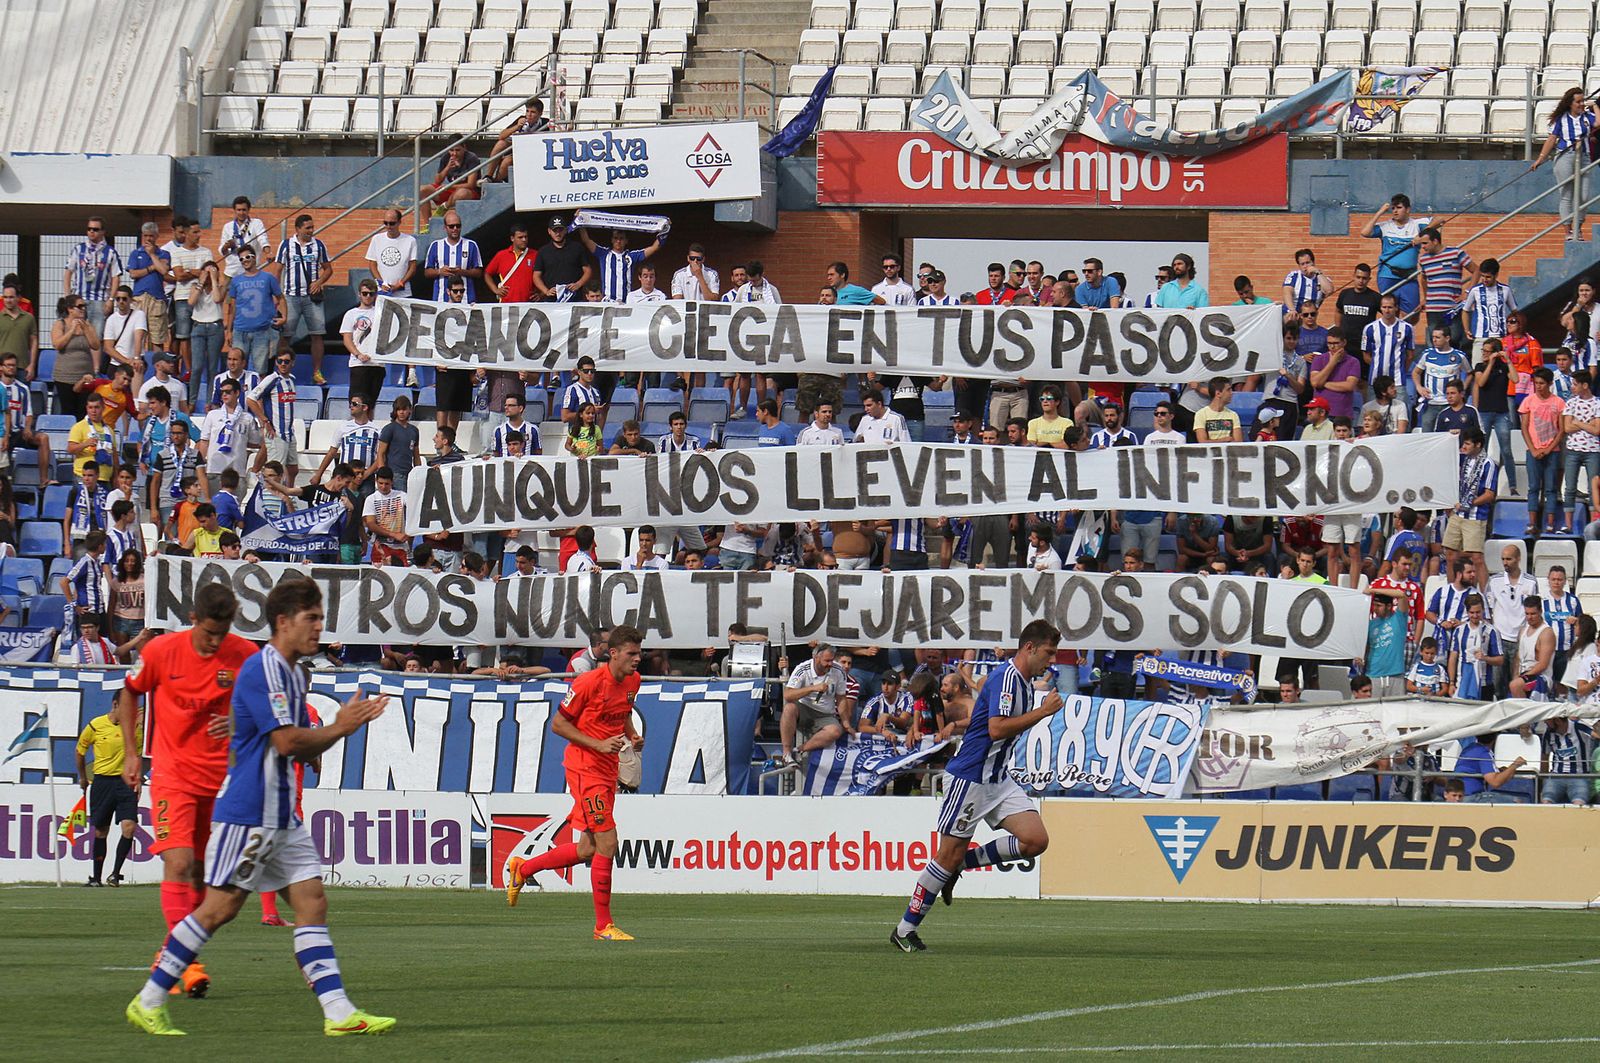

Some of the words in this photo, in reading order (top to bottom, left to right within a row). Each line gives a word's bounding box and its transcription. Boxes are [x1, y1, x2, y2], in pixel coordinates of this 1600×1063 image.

[699, 80, 751, 92] SECTO
[542, 131, 649, 170] Huelva
[685, 151, 732, 168] CEOSA
[569, 166, 599, 183] me
[606, 163, 649, 185] pone
[897, 138, 1171, 202] Cruzcampo
[540, 195, 548, 203] Y
[549, 194, 563, 203] EL
[566, 192, 604, 202] RECRE
[607, 187, 656, 200] TAMBIÉN
[241, 289, 263, 318] 3
[567, 305, 632, 360] FE
[827, 309, 898, 367] EN
[918, 308, 1036, 372] TUS
[419, 458, 623, 528] AUNQUE
[646, 449, 759, 517] NOS
[785, 445, 1007, 511] LLEVEN
[1027, 451, 1097, 502] AL
[245, 538, 307, 552] GUARDIANES
[156, 559, 480, 638] NSTROS
[493, 572, 673, 639] NUNCA
[699, 571, 771, 638] TE
[799, 574, 1143, 642] DEJAREMOS
[1169, 577, 1336, 649] SOLO
[1168, 661, 1232, 682] Recreativo
[1008, 690, 1126, 792] 889
[1058, 764, 1114, 786] Recre
[157, 800, 169, 822] 2
[585, 793, 605, 815] 16
[964, 802, 975, 821] 4
[311, 809, 462, 866] Otilia
[1215, 824, 1518, 874] JUNKERS
[402, 873, 463, 887] 1967
